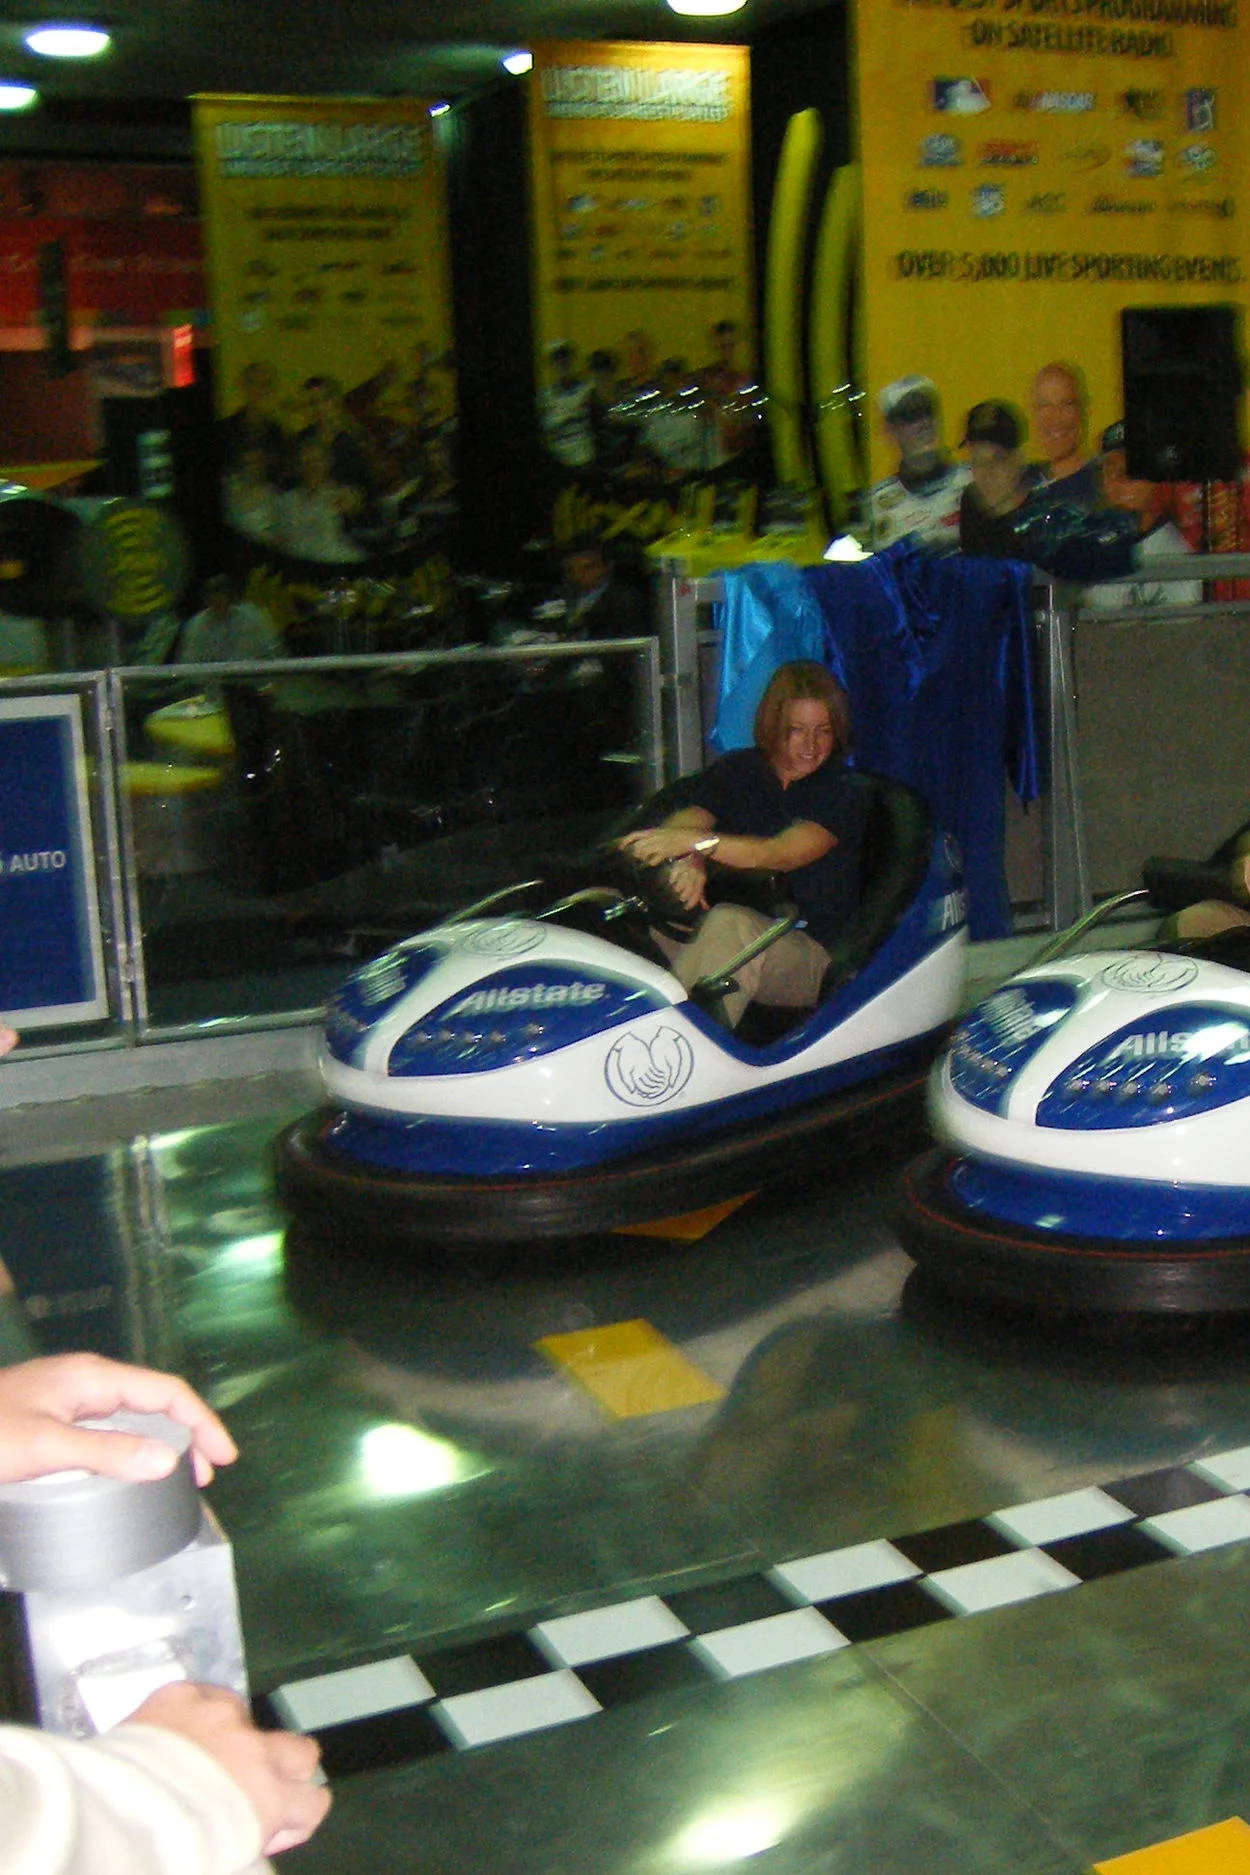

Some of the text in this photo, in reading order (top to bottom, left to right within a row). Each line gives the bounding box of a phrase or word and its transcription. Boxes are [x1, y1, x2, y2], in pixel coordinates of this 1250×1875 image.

[968, 18, 1004, 47] ON
[10, 850, 66, 873] AUTO
[440, 981, 606, 1022] Allstate
